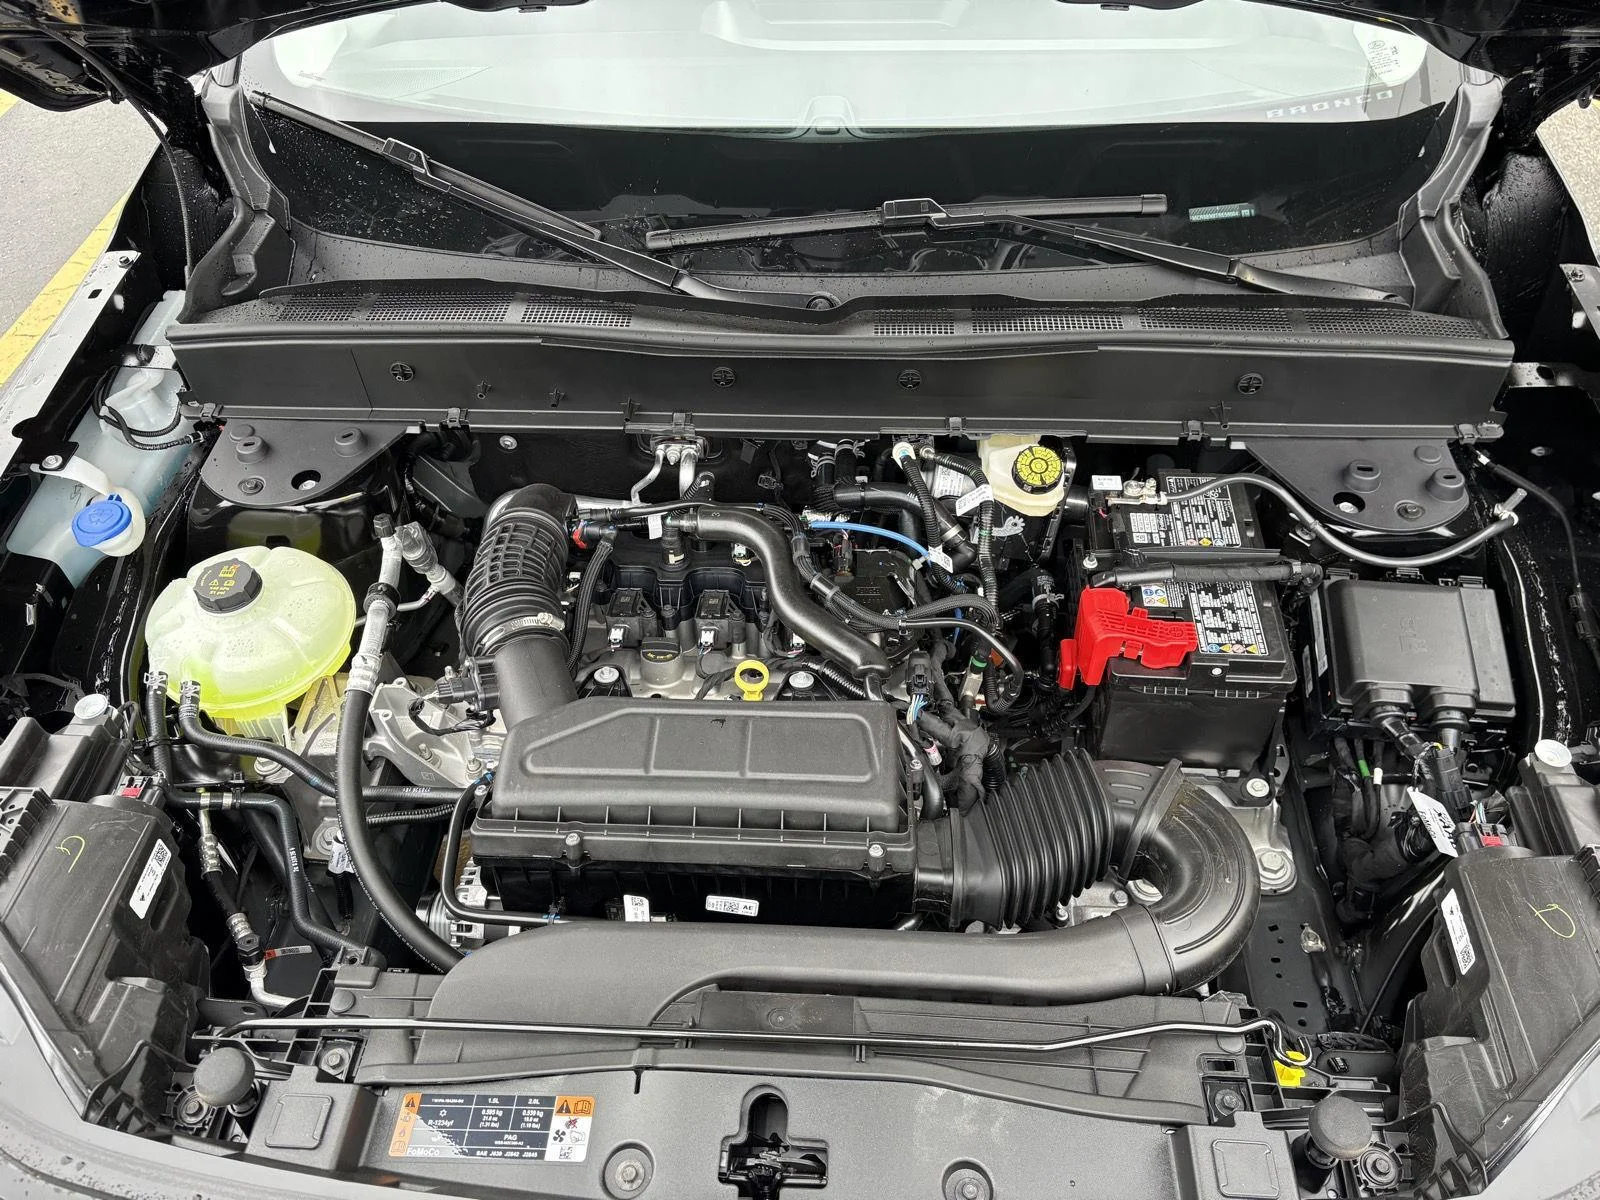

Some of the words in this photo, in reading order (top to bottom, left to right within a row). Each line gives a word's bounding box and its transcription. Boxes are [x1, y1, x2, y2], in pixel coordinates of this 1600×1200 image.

[1266, 89, 1393, 119] BRONCO
[428, 1119, 454, 1127] R-1234yf
[407, 1148, 439, 1156] FoMoCo
